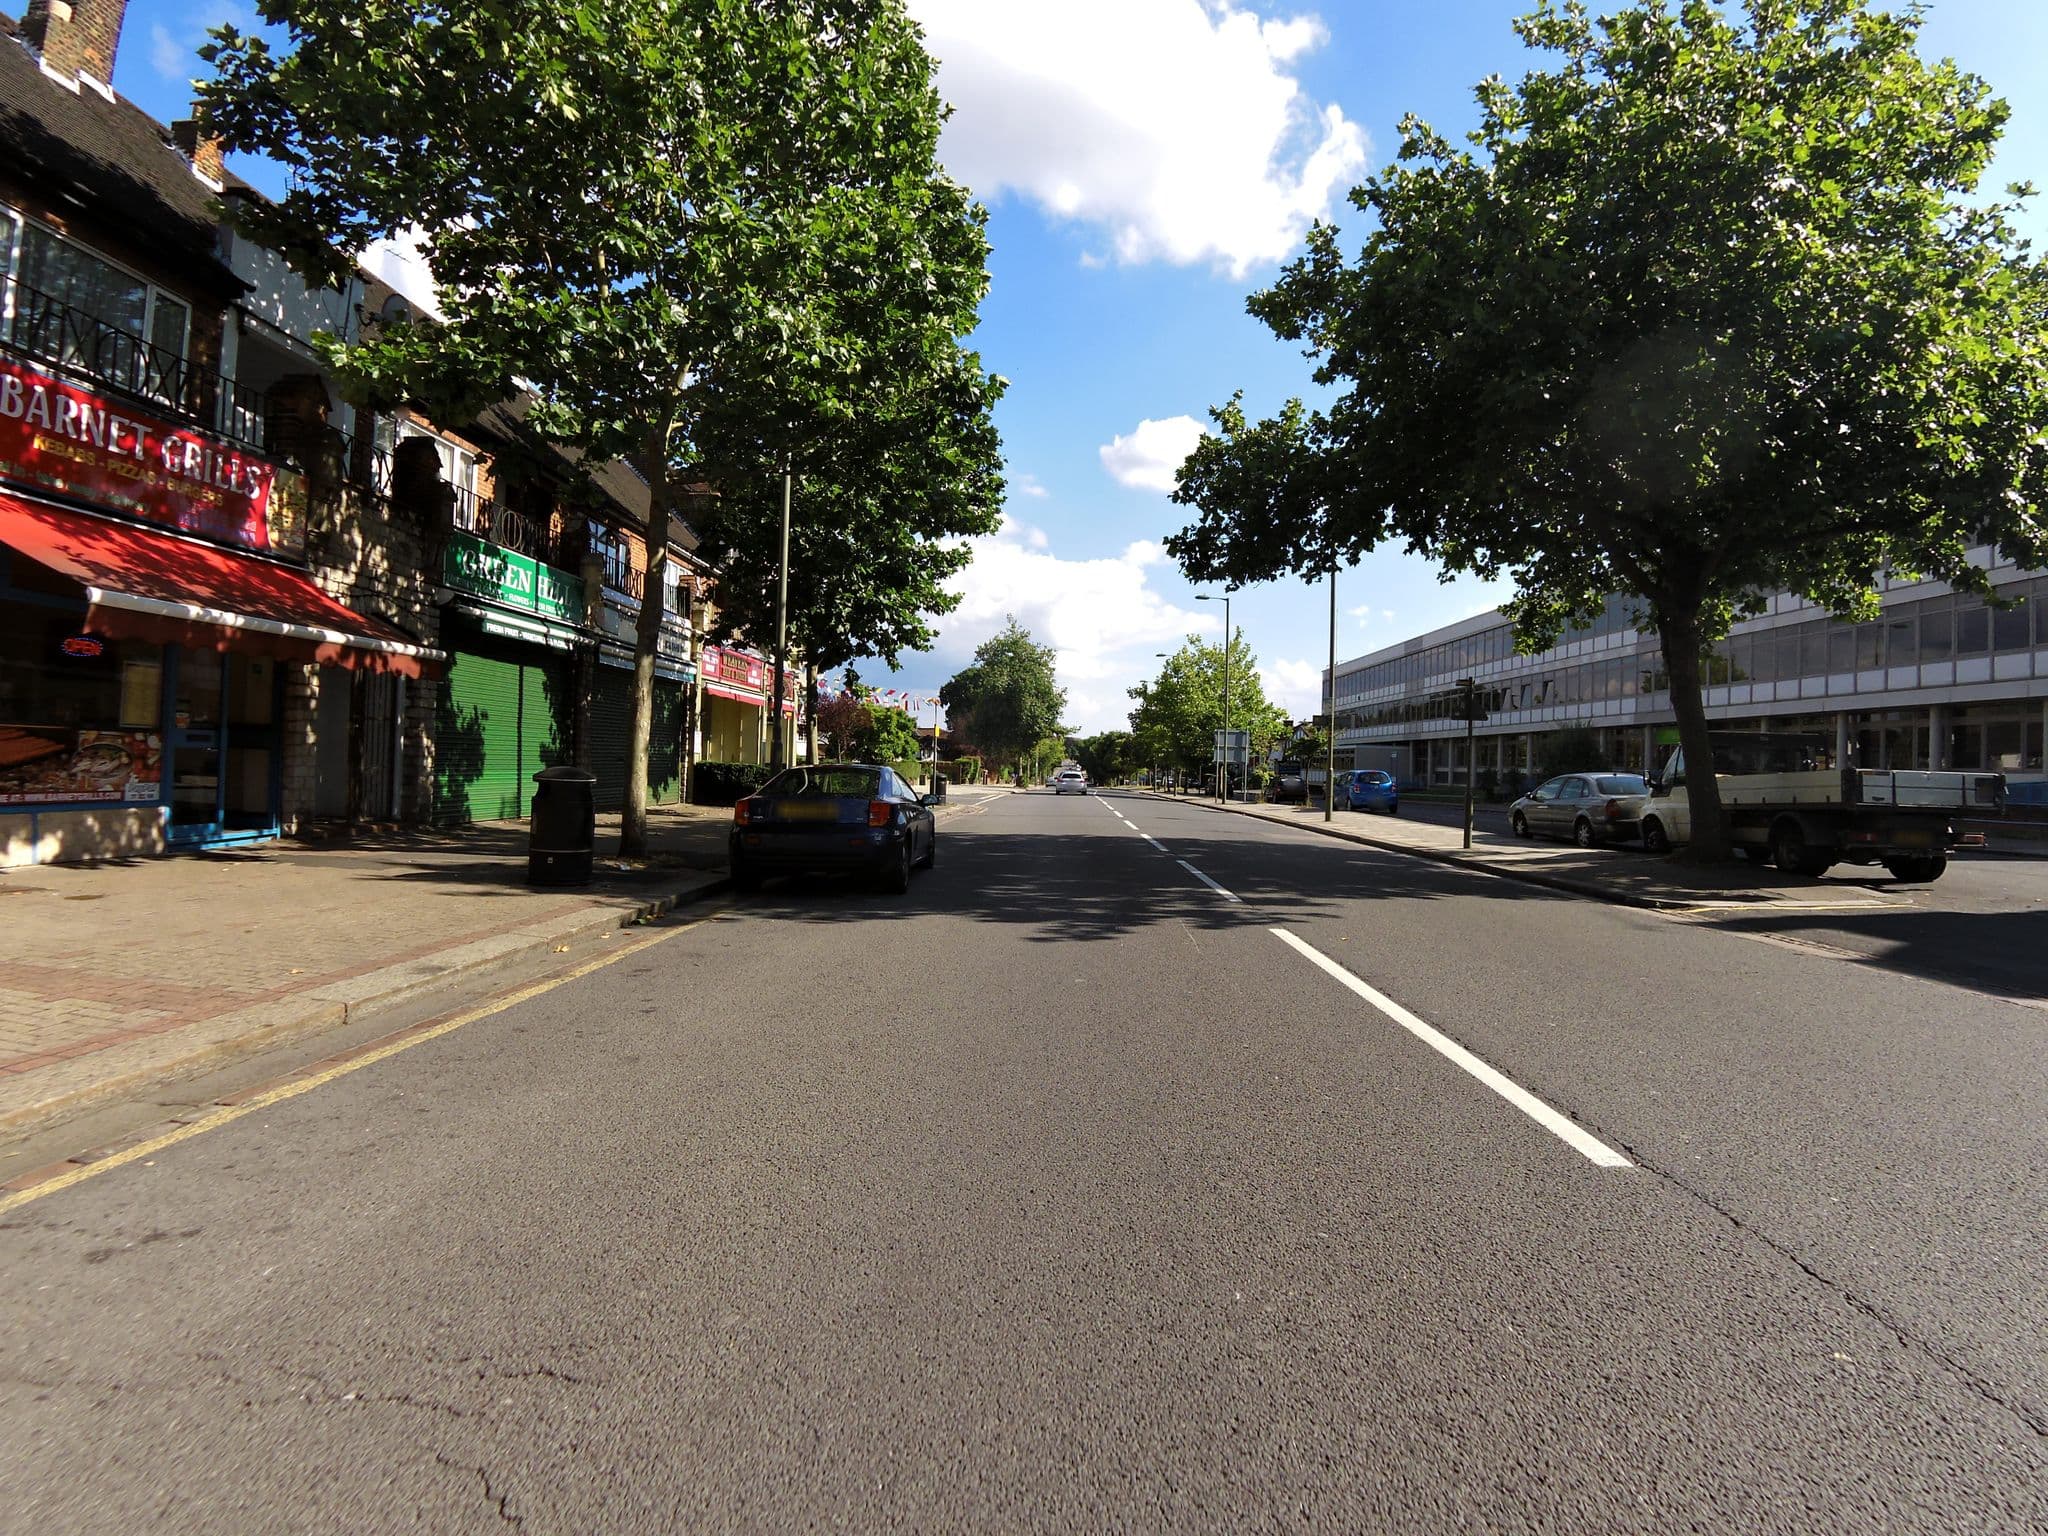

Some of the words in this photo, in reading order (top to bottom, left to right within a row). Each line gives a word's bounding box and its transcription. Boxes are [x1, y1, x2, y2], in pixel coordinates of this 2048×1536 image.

[0, 373, 153, 461] BARNET
[161, 436, 262, 500] GRILLS
[33, 434, 96, 467] KEBABS
[107, 459, 157, 485] PIZZAS
[166, 477, 224, 506] BURGERS
[463, 549, 533, 594] GREEN
[538, 575, 573, 607] HILL
